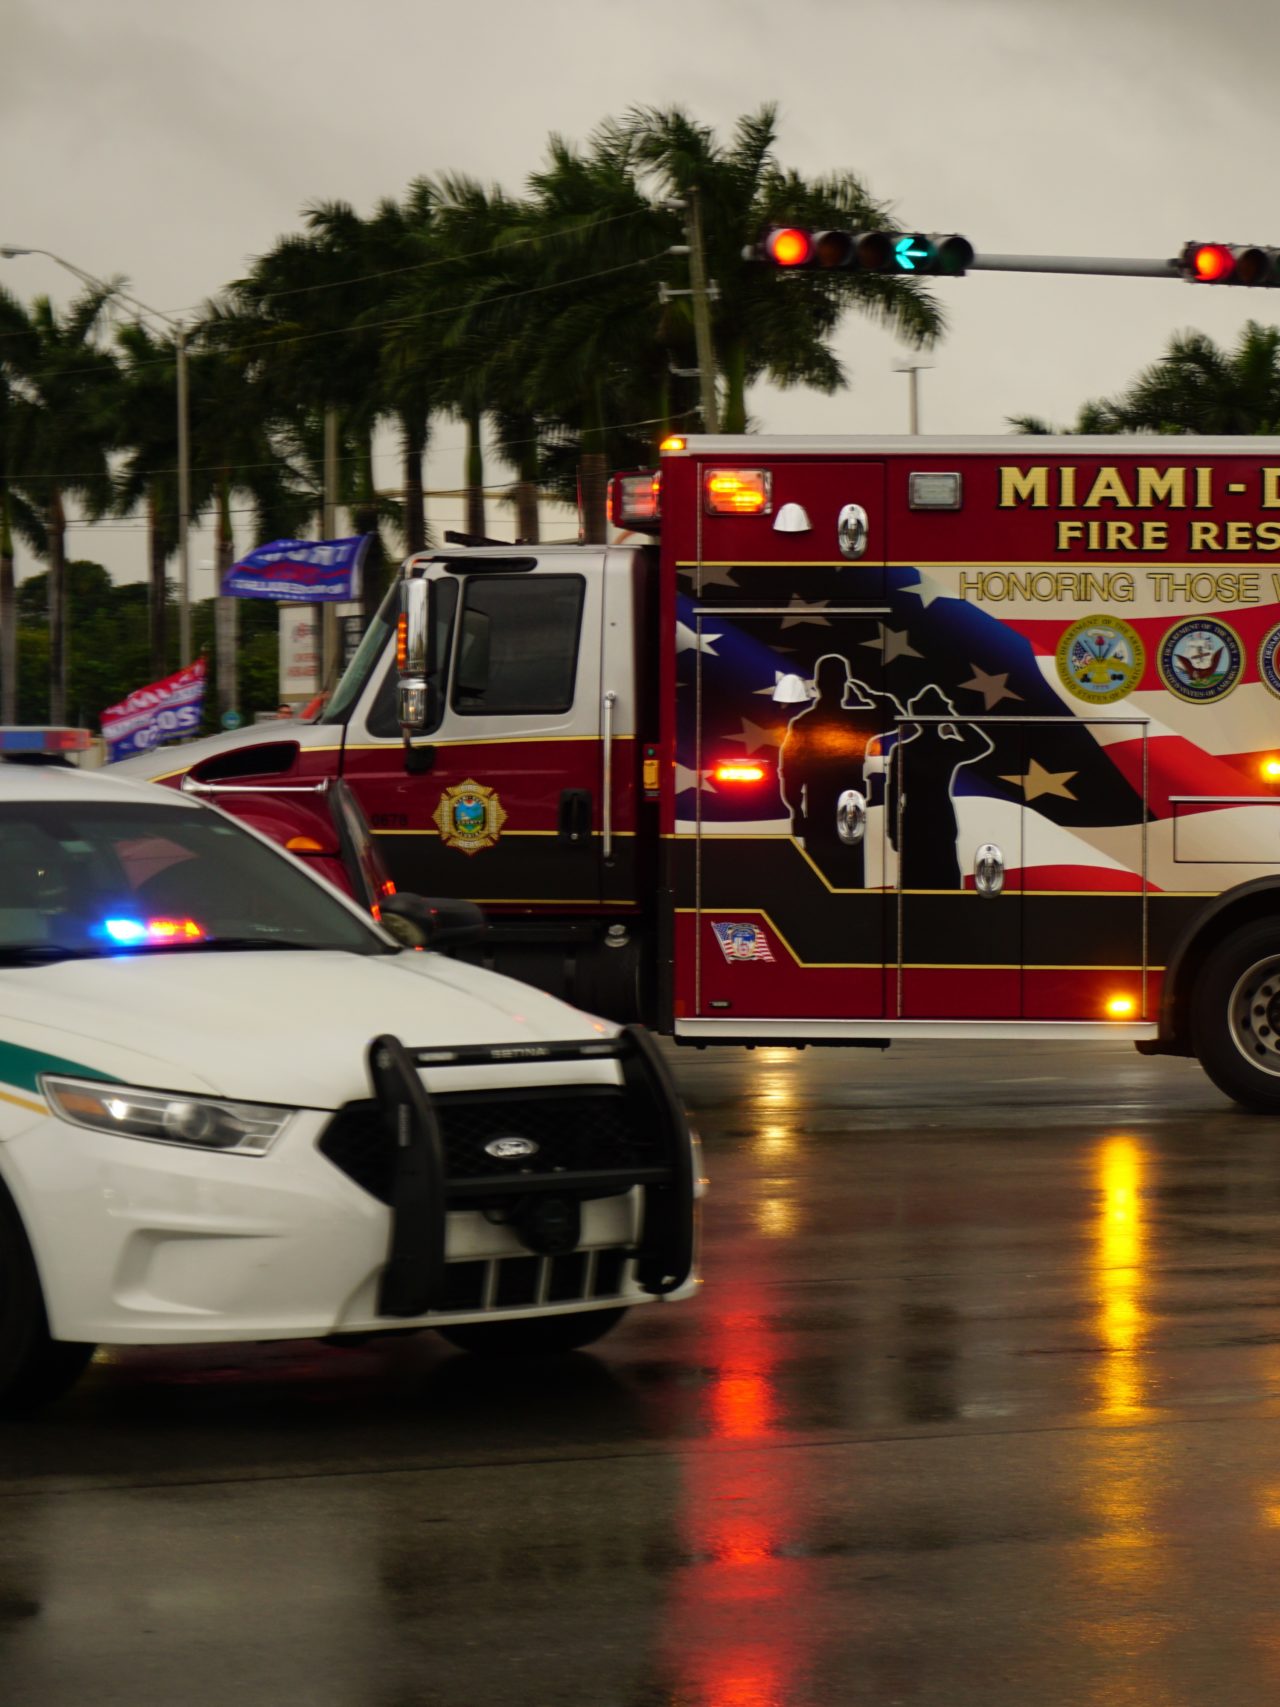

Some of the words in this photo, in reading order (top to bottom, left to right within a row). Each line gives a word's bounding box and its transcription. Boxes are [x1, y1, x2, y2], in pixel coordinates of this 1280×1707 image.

[1056, 521, 1169, 551] FIRE
[958, 571, 1135, 602] HONORING
[1146, 572, 1260, 603] THOSE
